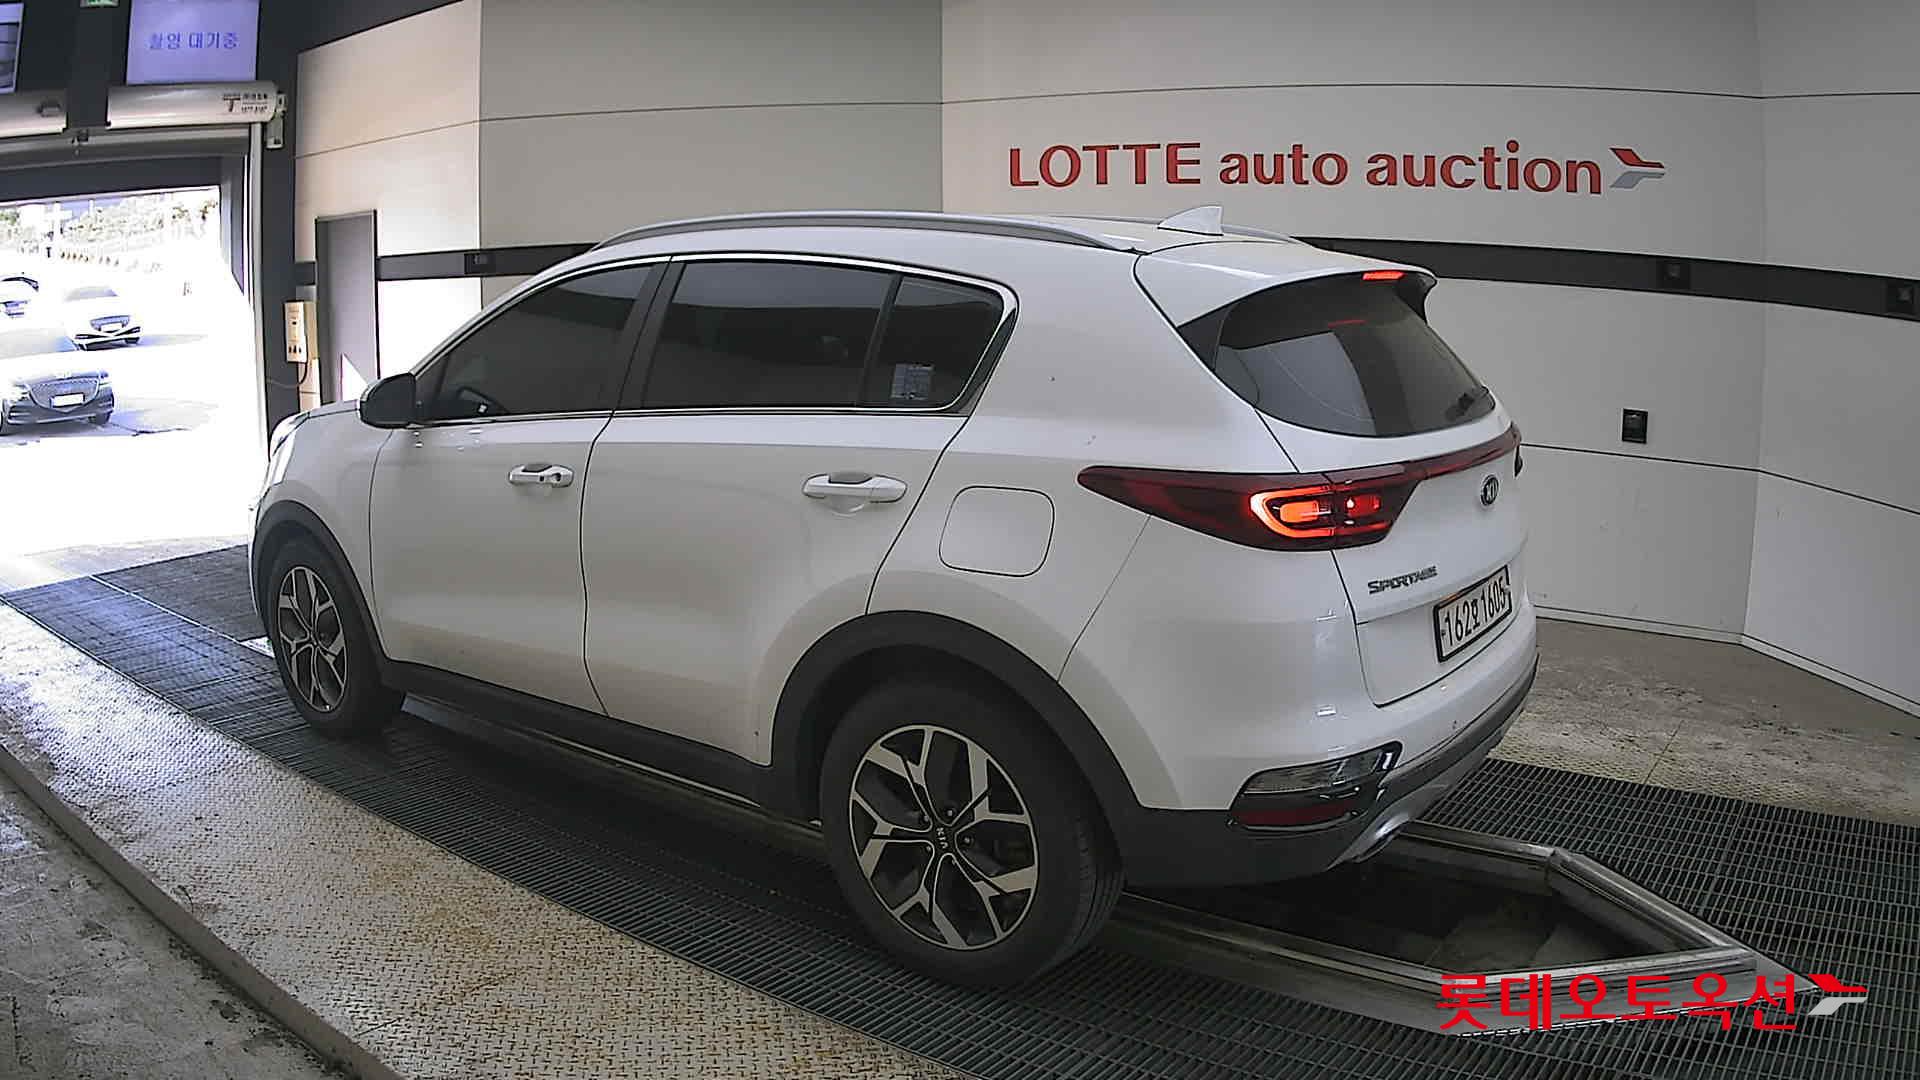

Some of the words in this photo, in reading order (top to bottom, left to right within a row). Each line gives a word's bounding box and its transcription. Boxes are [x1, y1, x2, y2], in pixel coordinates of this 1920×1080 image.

[1009, 143, 1201, 187] LOTTE
[1219, 145, 1348, 186] auto
[1366, 140, 1602, 194] auction
[1480, 576, 1506, 622] 1605
